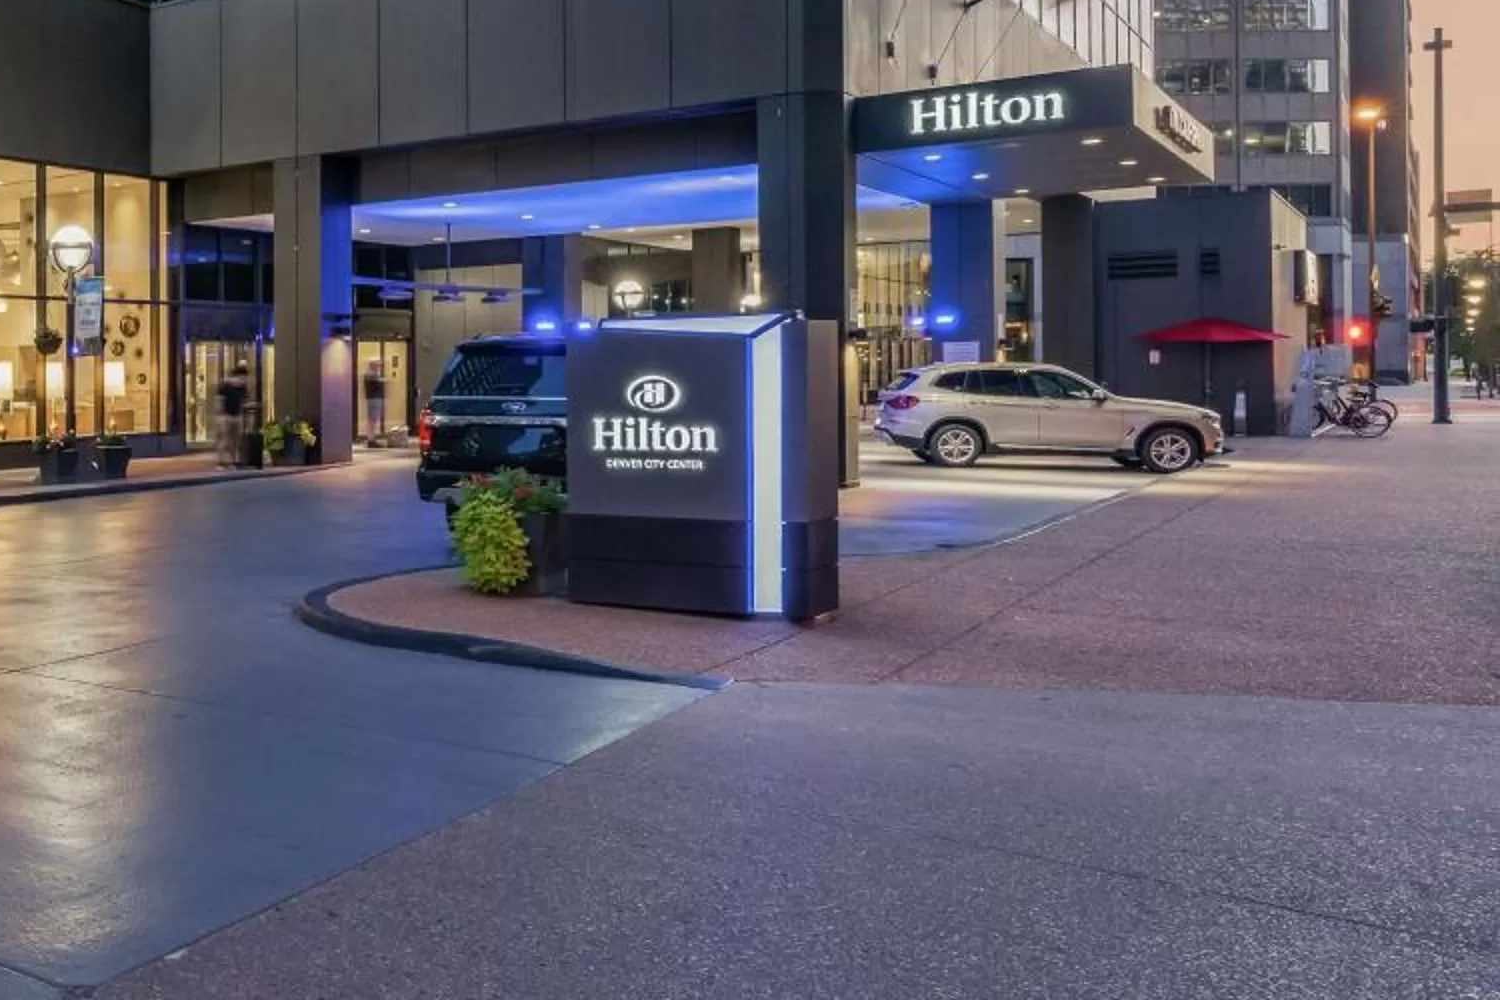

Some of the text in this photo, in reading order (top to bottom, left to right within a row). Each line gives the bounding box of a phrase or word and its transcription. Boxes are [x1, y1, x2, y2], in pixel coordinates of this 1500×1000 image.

[910, 91, 1065, 135] Hilton
[592, 416, 719, 452] Hilton
[605, 457, 704, 470] DENVER CITY CENTER
